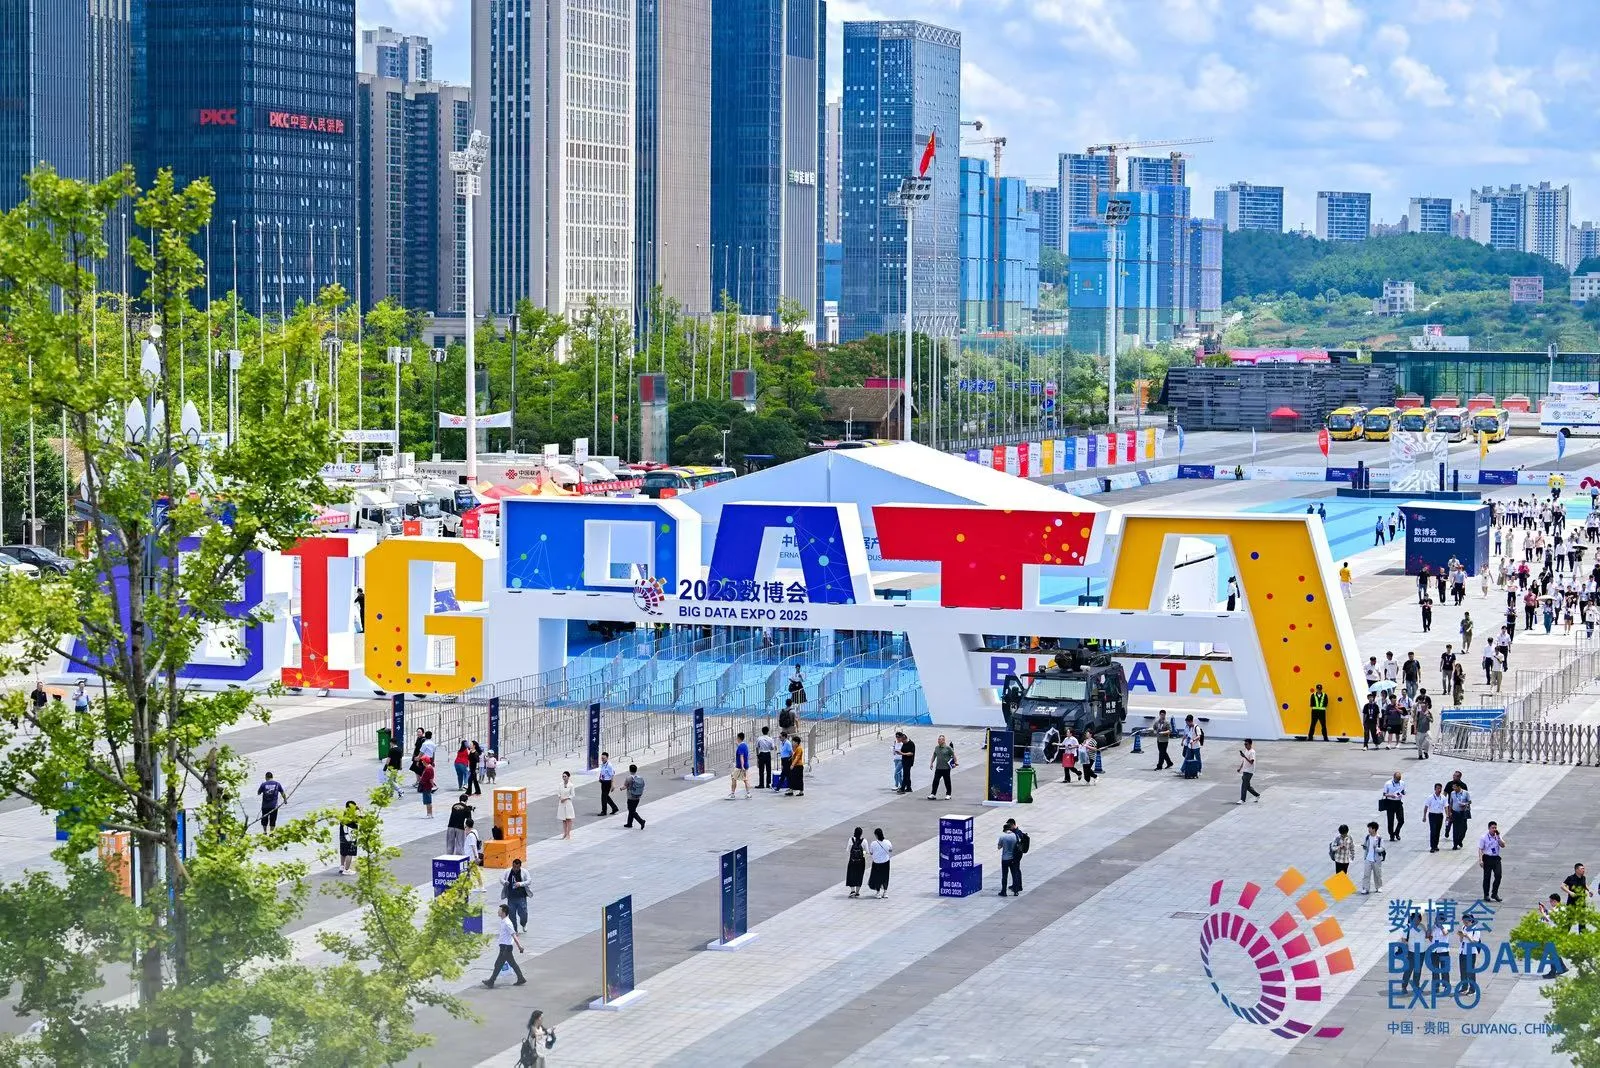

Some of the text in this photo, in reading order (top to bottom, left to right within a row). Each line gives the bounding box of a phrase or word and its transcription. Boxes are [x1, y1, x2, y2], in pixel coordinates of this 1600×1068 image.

[200, 109, 236, 125] PICC
[270, 111, 344, 133] PICC 中国人民保险
[1413, 528, 1437, 536] 数博会
[679, 579, 808, 604] 2025数博会
[679, 606, 808, 621] BIG DATA EXPO 2025
